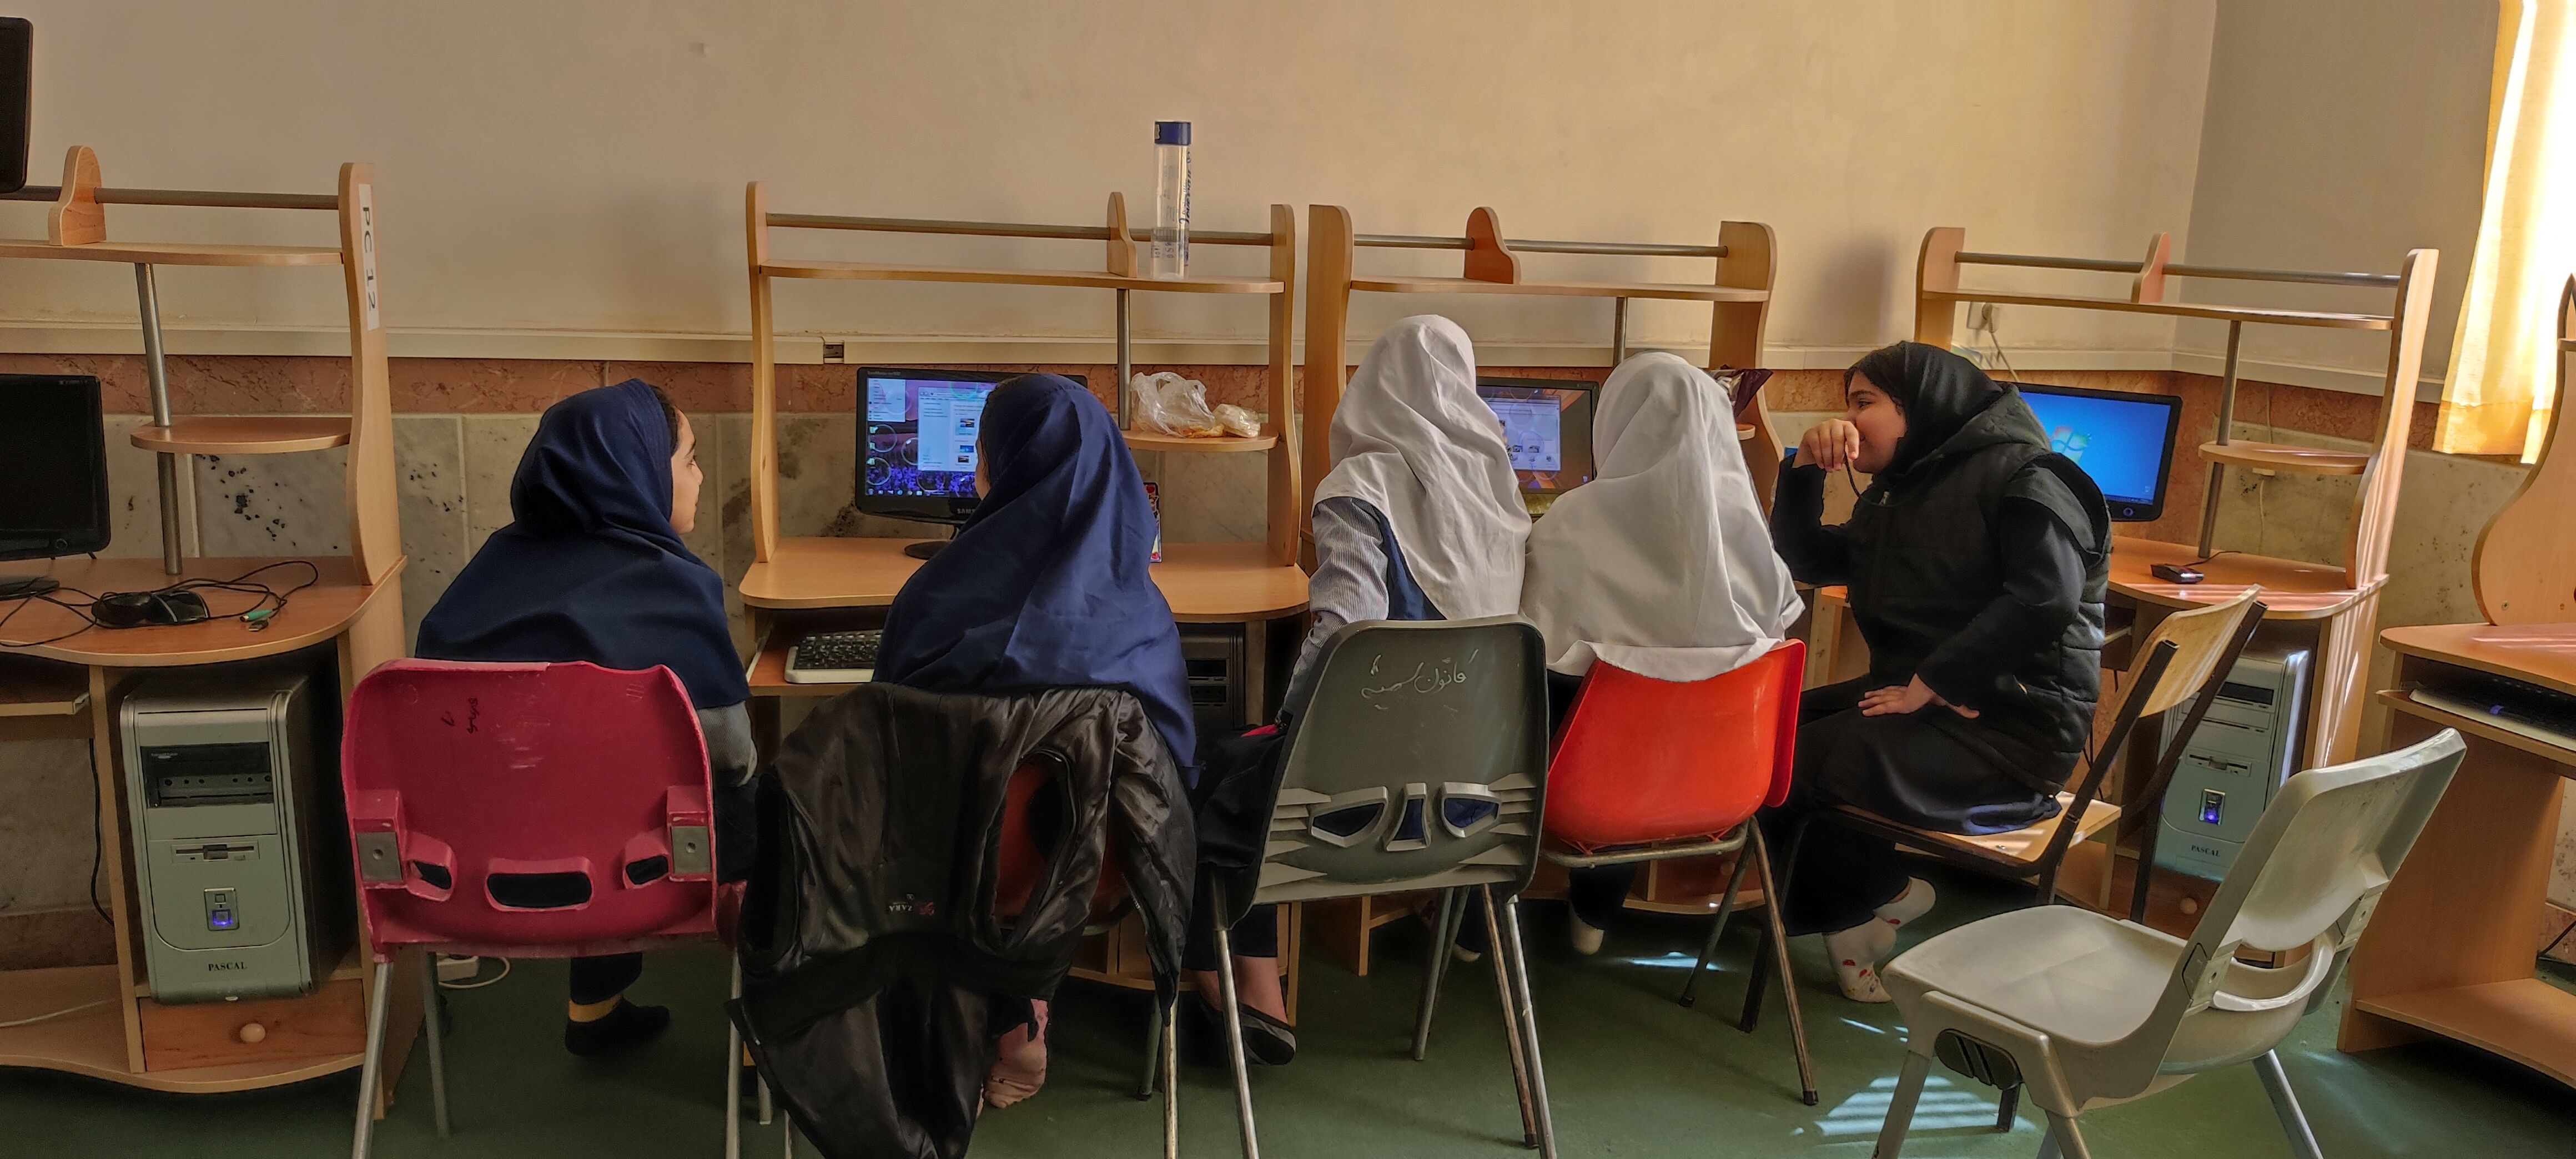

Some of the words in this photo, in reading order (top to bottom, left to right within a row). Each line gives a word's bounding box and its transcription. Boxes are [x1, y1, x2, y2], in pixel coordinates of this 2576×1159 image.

[363, 207, 372, 254] PC
[366, 269, 376, 311] 12
[2191, 844, 2220, 857] PASCAL
[208, 961, 248, 971] PASCAL
